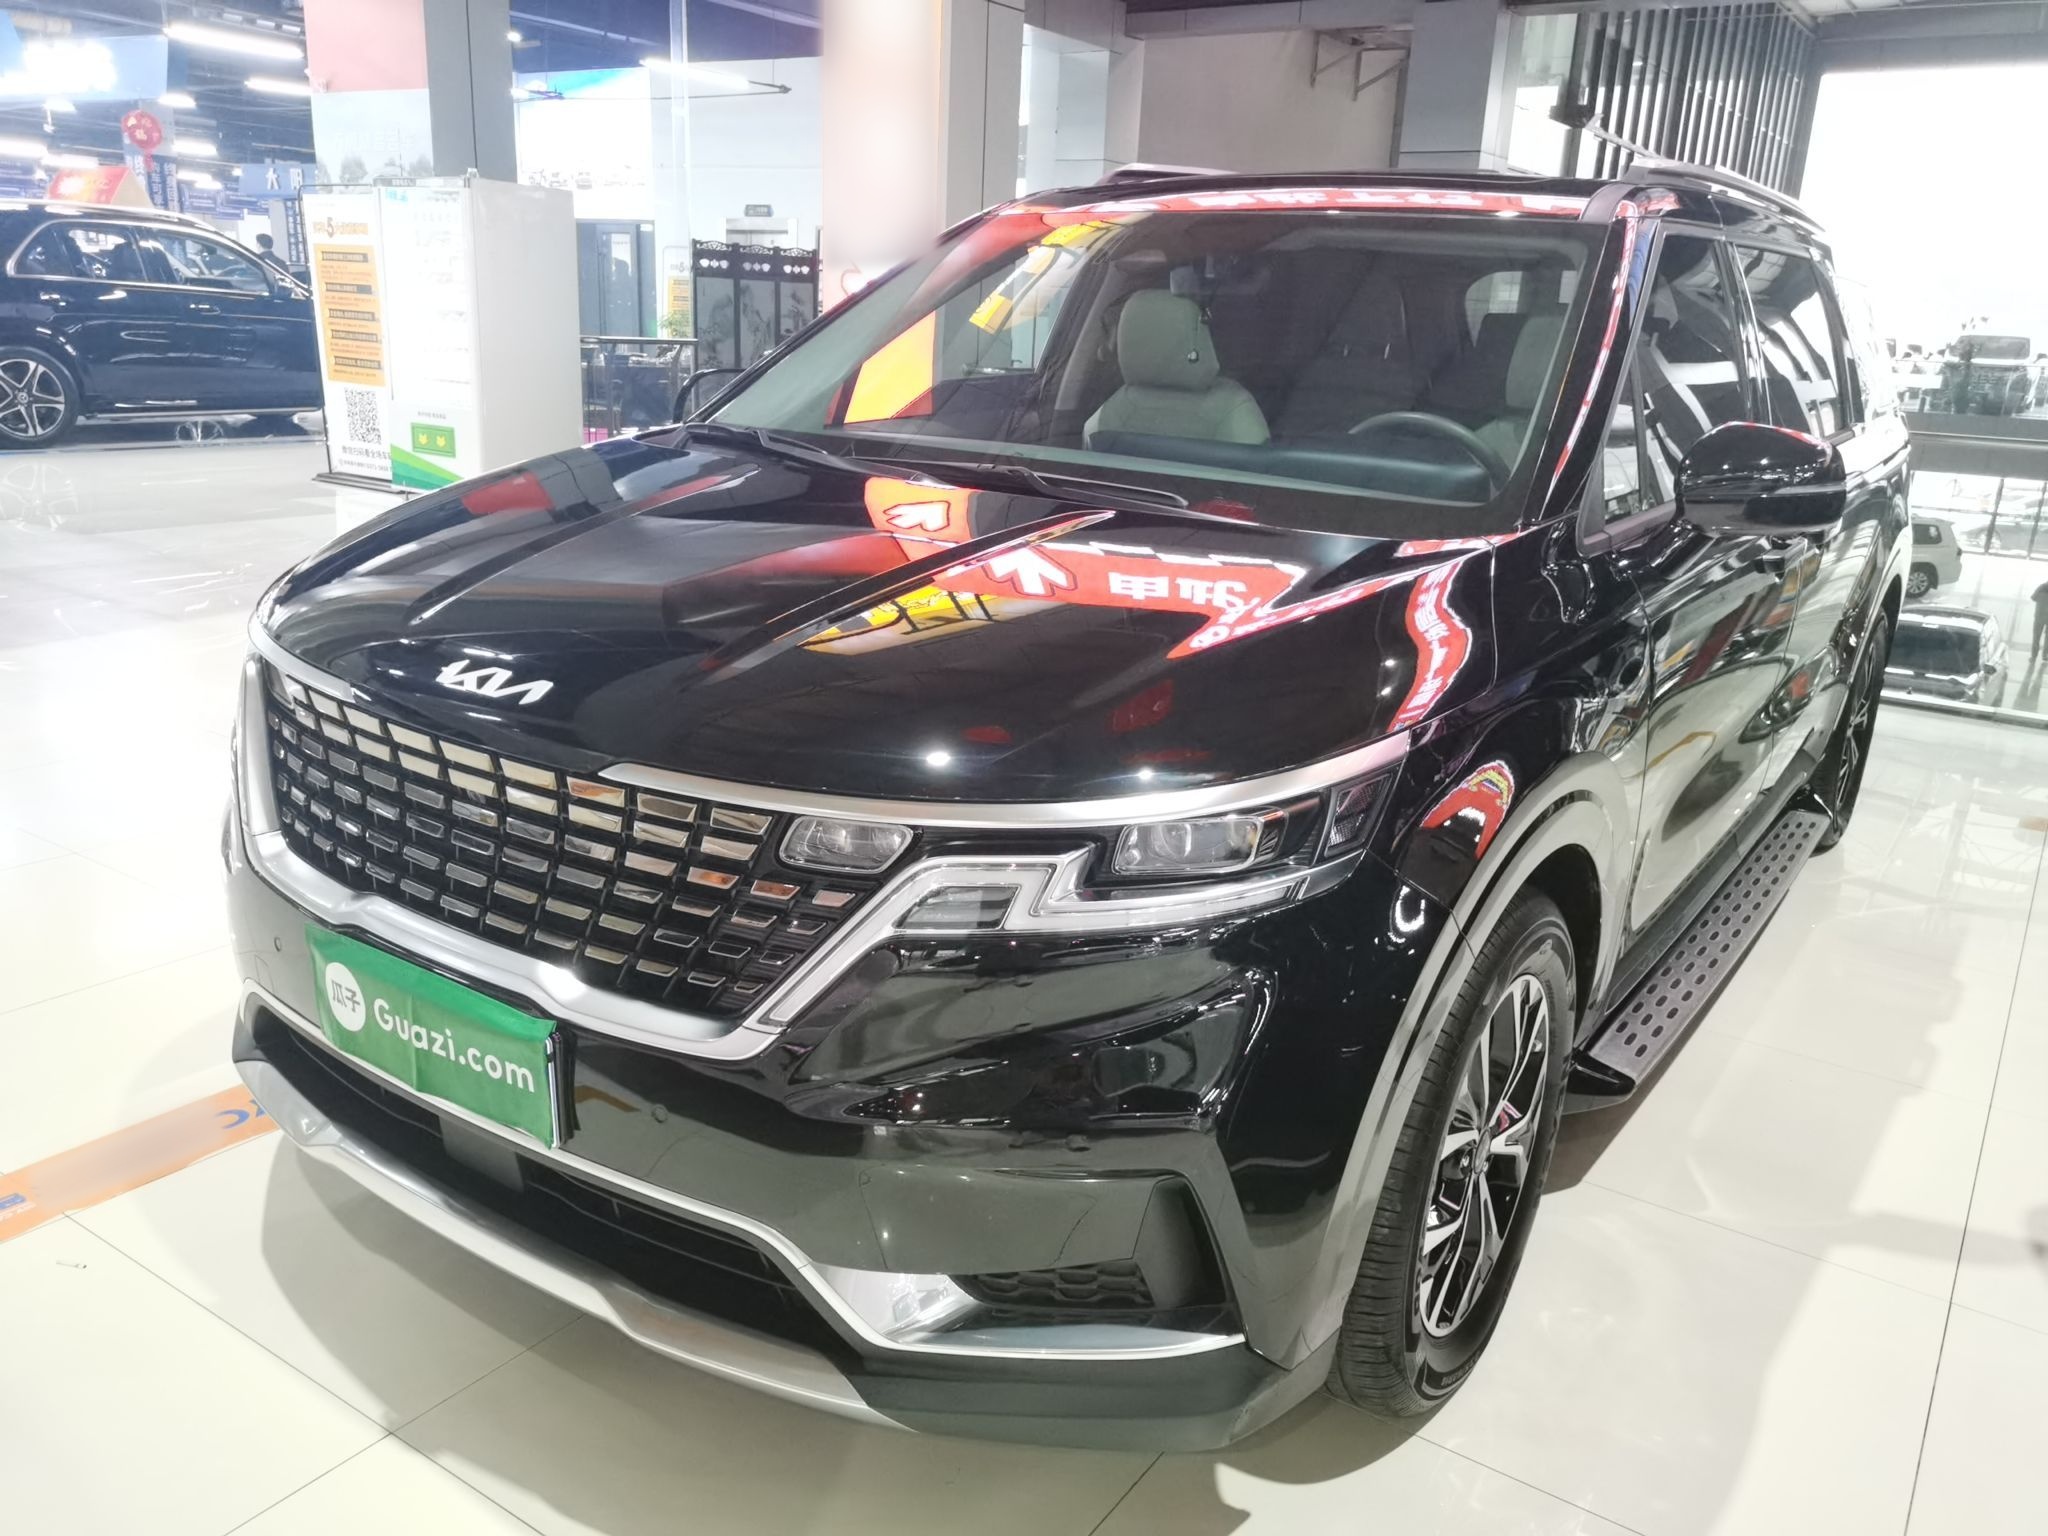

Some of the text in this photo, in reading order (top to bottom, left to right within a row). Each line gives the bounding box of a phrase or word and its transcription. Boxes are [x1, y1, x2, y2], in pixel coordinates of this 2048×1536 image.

[435, 658, 554, 705] KIA
[331, 979, 361, 1013] 瓜子
[373, 997, 536, 1093] Guazi.com
